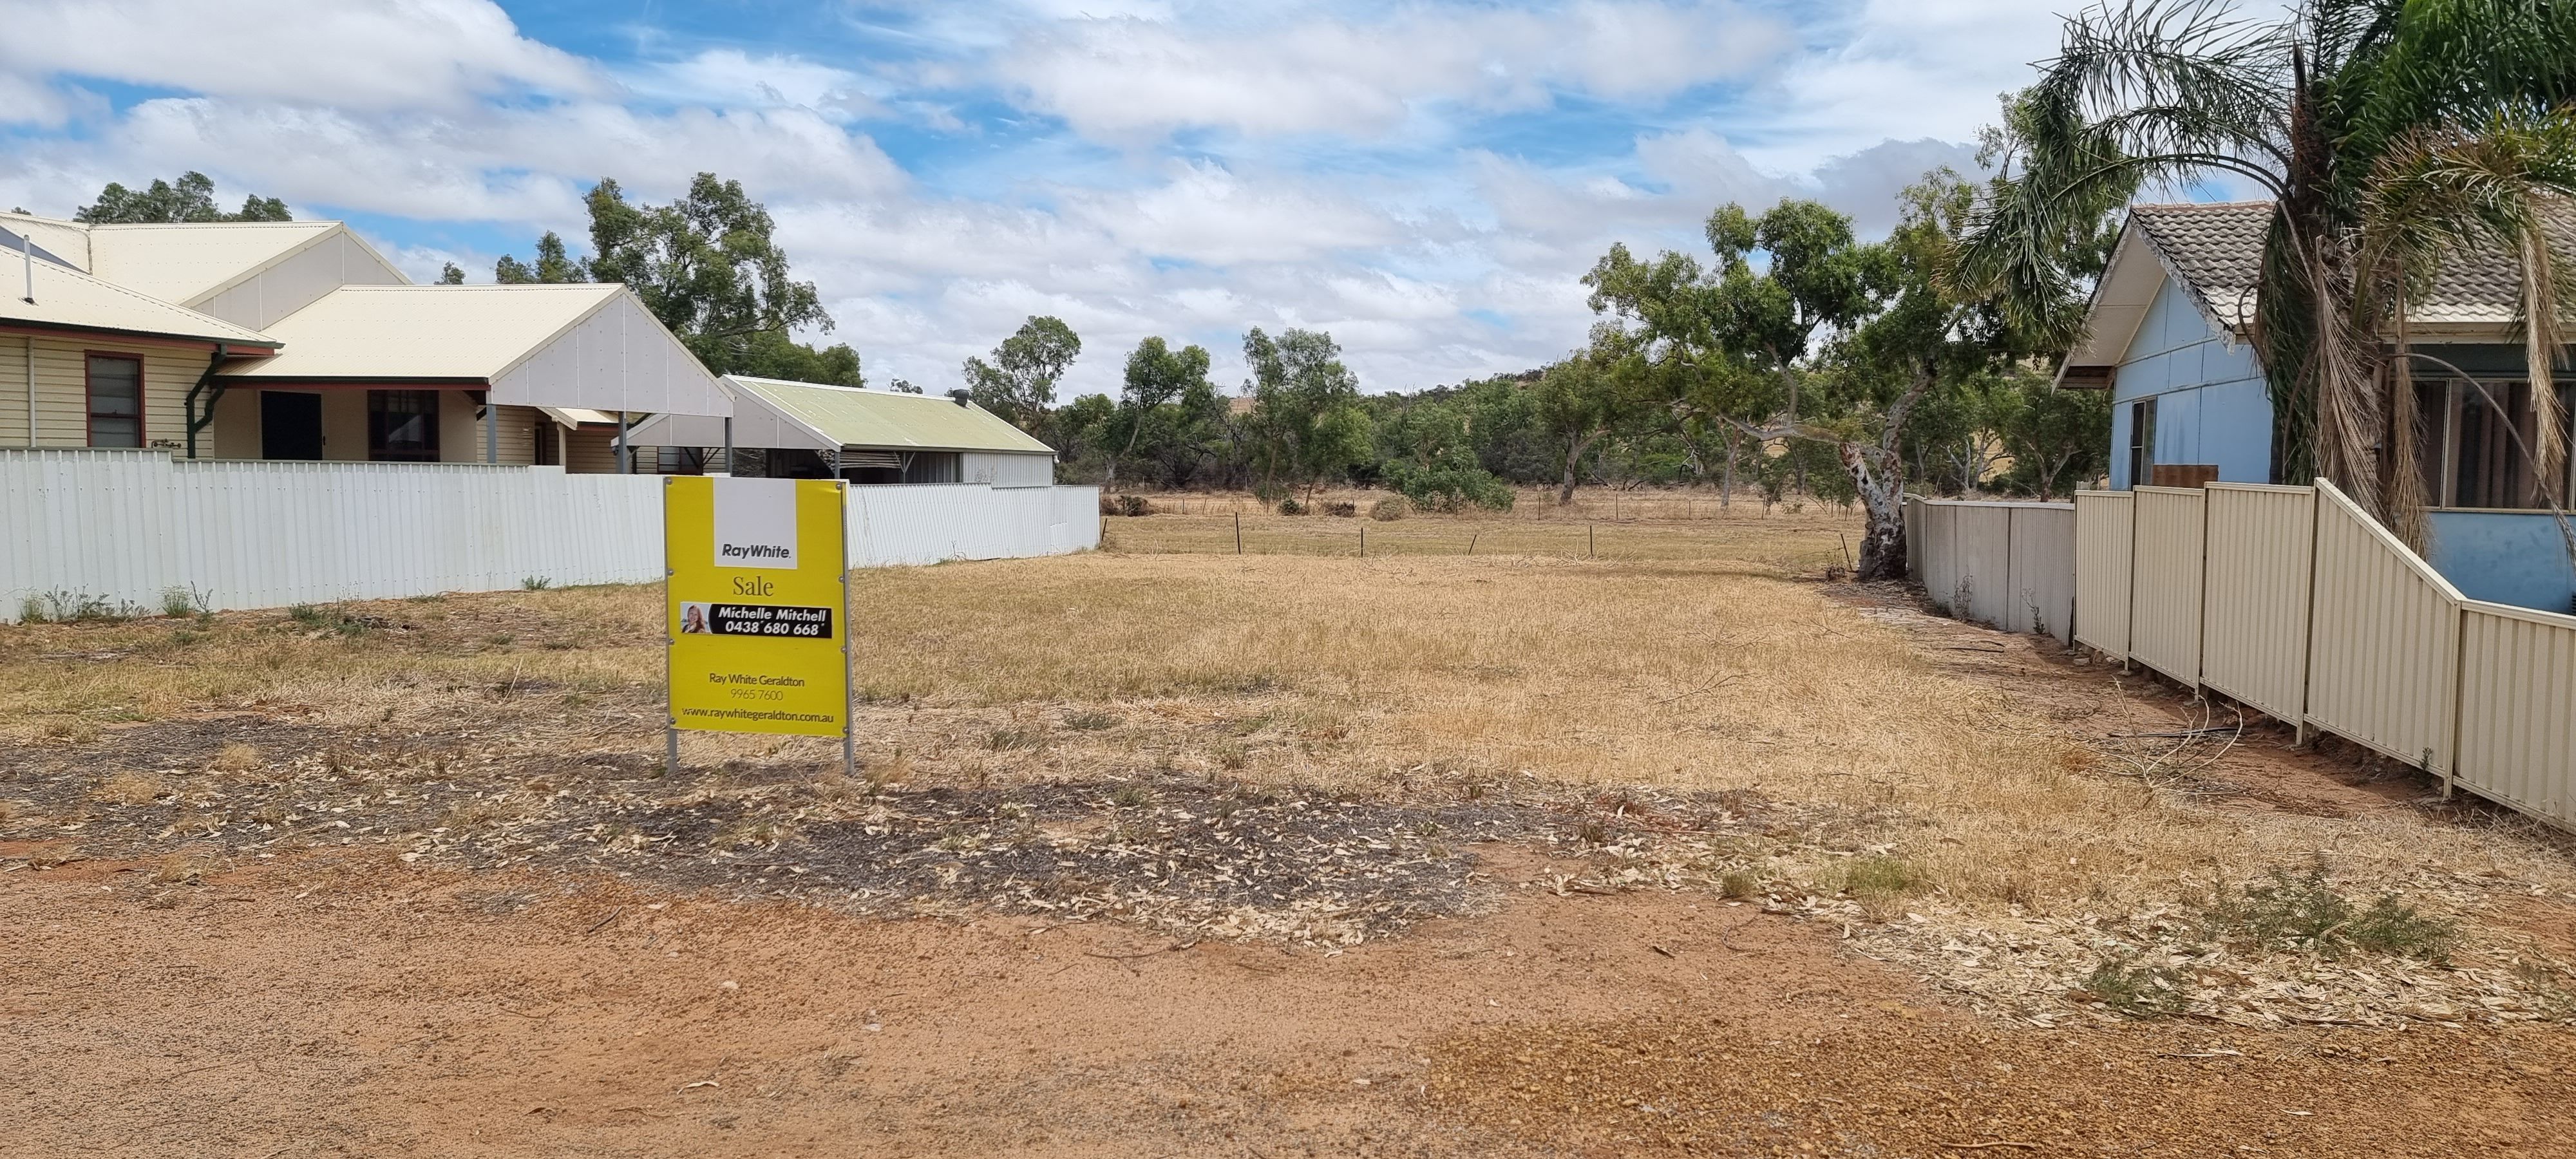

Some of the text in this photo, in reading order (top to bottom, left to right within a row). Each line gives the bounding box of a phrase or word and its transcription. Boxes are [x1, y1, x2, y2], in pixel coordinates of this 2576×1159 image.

[733, 576, 774, 596] Sale
[718, 607, 826, 622] Michelle Mitchell
[725, 621, 819, 636] 0438 680 668
[710, 674, 805, 687] Ray White Geraldton
[730, 690, 784, 701] 9965 7600
[681, 708, 834, 723] www.raywhitegeraldton.com.au
